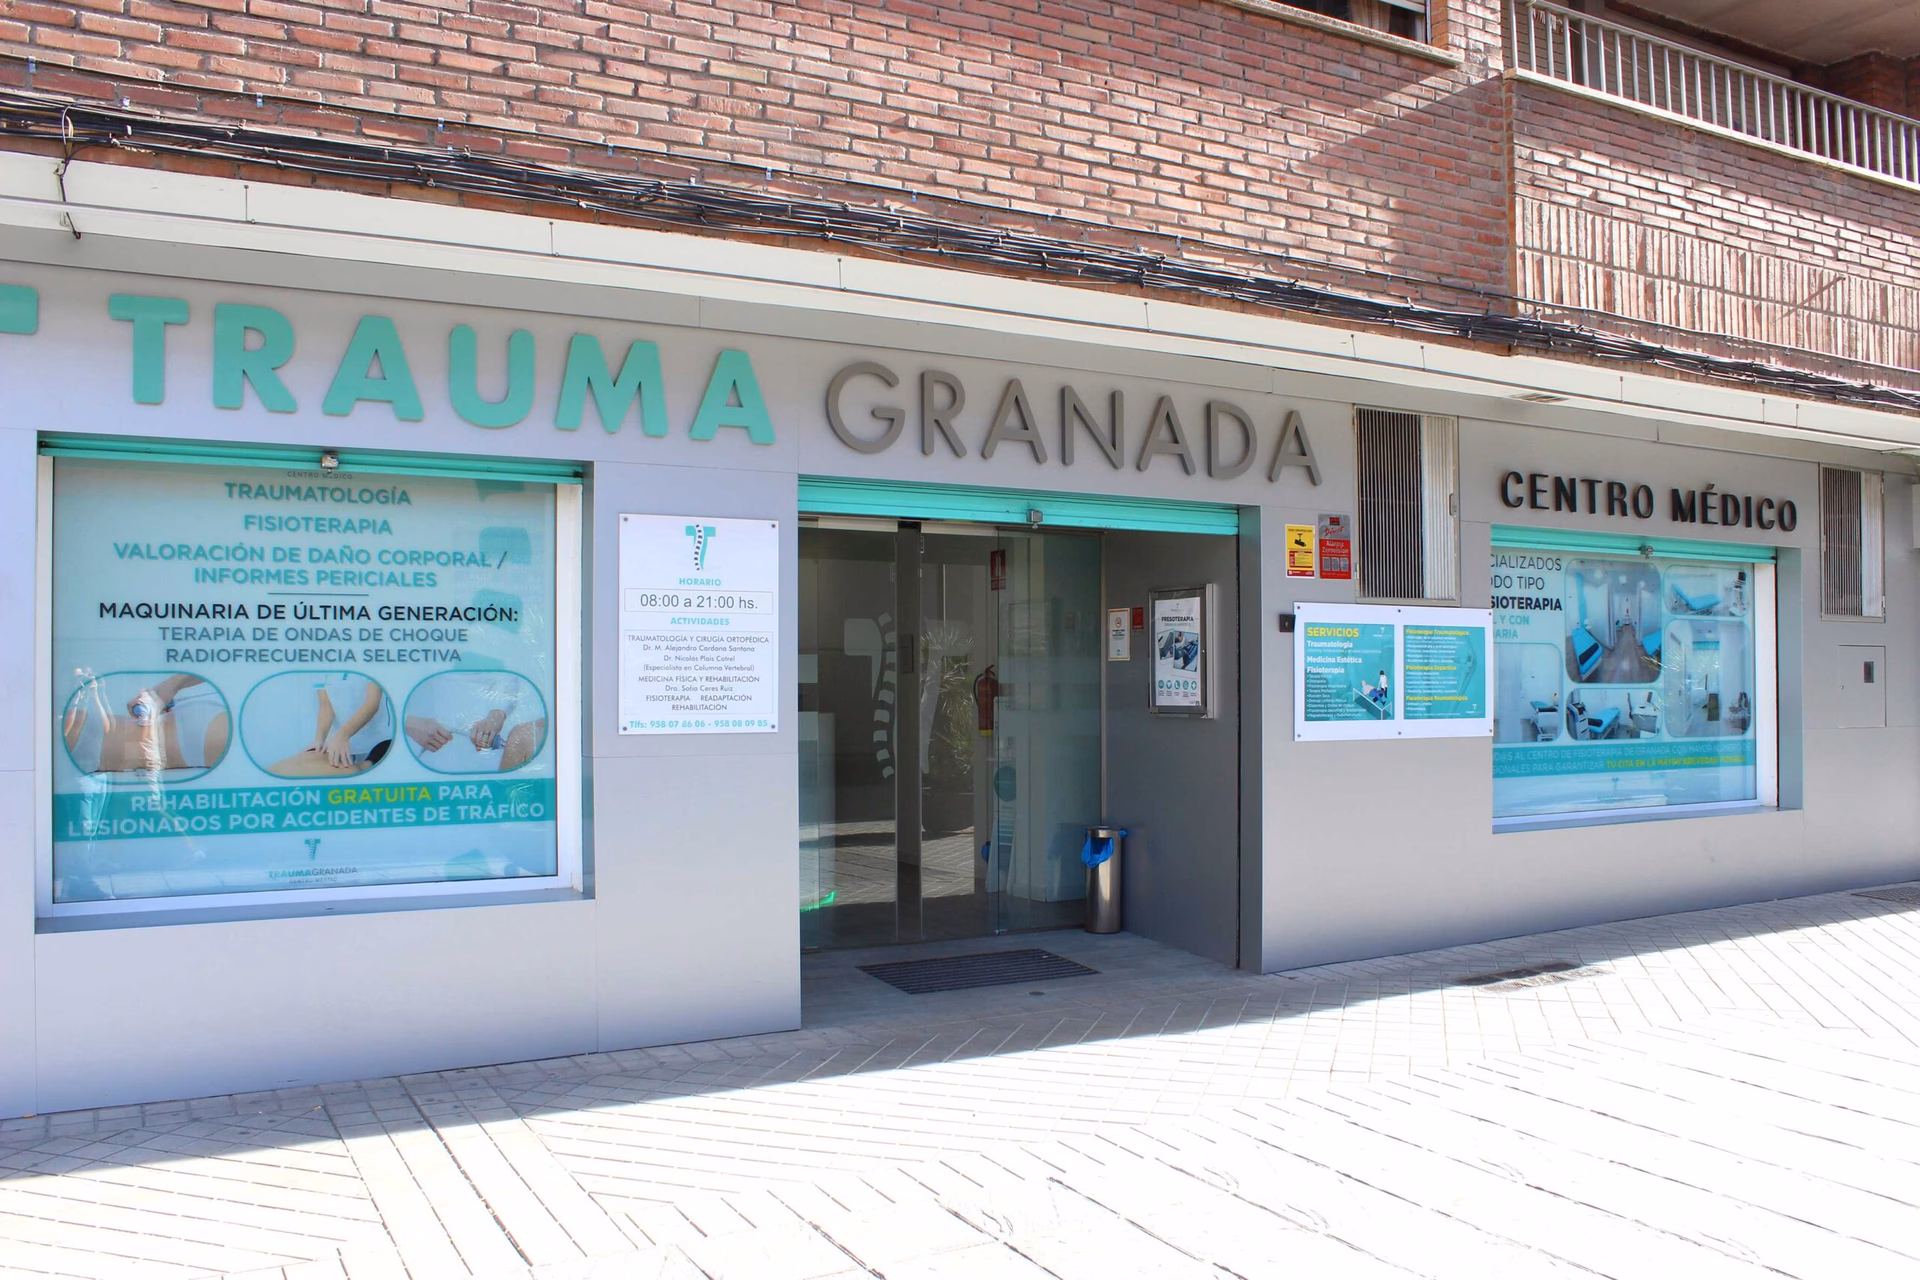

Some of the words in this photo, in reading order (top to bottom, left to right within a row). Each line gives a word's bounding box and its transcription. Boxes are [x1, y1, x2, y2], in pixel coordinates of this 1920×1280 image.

[109, 294, 776, 445] TRAUMA
[826, 361, 1323, 486] GRANADA
[224, 482, 412, 506] TRAUMATOLOGÍA
[1501, 471, 1655, 519] CENTRO
[1671, 483, 1798, 532] MÉDICO
[243, 515, 393, 535] FISIOTERAPIA
[113, 542, 265, 562] VALORACIÓN
[272, 547, 301, 563] DE
[308, 545, 371, 565] DAÑO
[378, 550, 492, 568] CORPORAL
[194, 567, 308, 585] INFORMES
[316, 569, 438, 587] PERICIALES
[679, 578, 721, 586] HORARIO
[1491, 575, 1513, 589] DO
[1517, 576, 1545, 590] TIPO
[640, 594, 679, 607] 08:00
[684, 597, 692, 608] a
[696, 596, 734, 609] 21:00
[739, 597, 758, 609] hs.
[99, 602, 249, 619] MAQUINARIA
[257, 604, 286, 619] DE
[294, 601, 371, 620] ÚLTIMA
[378, 603, 518, 622] GENERACIÓN:
[670, 617, 730, 626] ACTIVIDADES
[1500, 615, 1506, 624] Y
[1509, 615, 1530, 625] CON
[158, 627, 245, 641] TERAPIA
[252, 627, 278, 641] DE
[285, 627, 352, 641] ONDAS
[358, 628, 383, 641] DE
[389, 628, 468, 643] CHOQUE
[1307, 627, 1359, 637] SERVICIOS
[665, 644, 697, 653] Alejandro
[1307, 640, 1353, 649] Traumatología
[166, 648, 356, 663] RADIOFRECUENCIA
[363, 648, 462, 663] SELECTIVA
[1307, 666, 1345, 675] Fisioterapia
[646, 694, 691, 702] FISIOTERAPIA
[131, 787, 320, 812] REHABILITACIÓN
[327, 786, 432, 805] GRATUITA
[438, 784, 493, 801] PARA
[68, 815, 221, 837] LESIONADOS
[229, 813, 275, 830] POR
[282, 806, 417, 827] ACCIDENTES
[423, 806, 450, 822] DE
[457, 801, 545, 820] TRÁFICO
